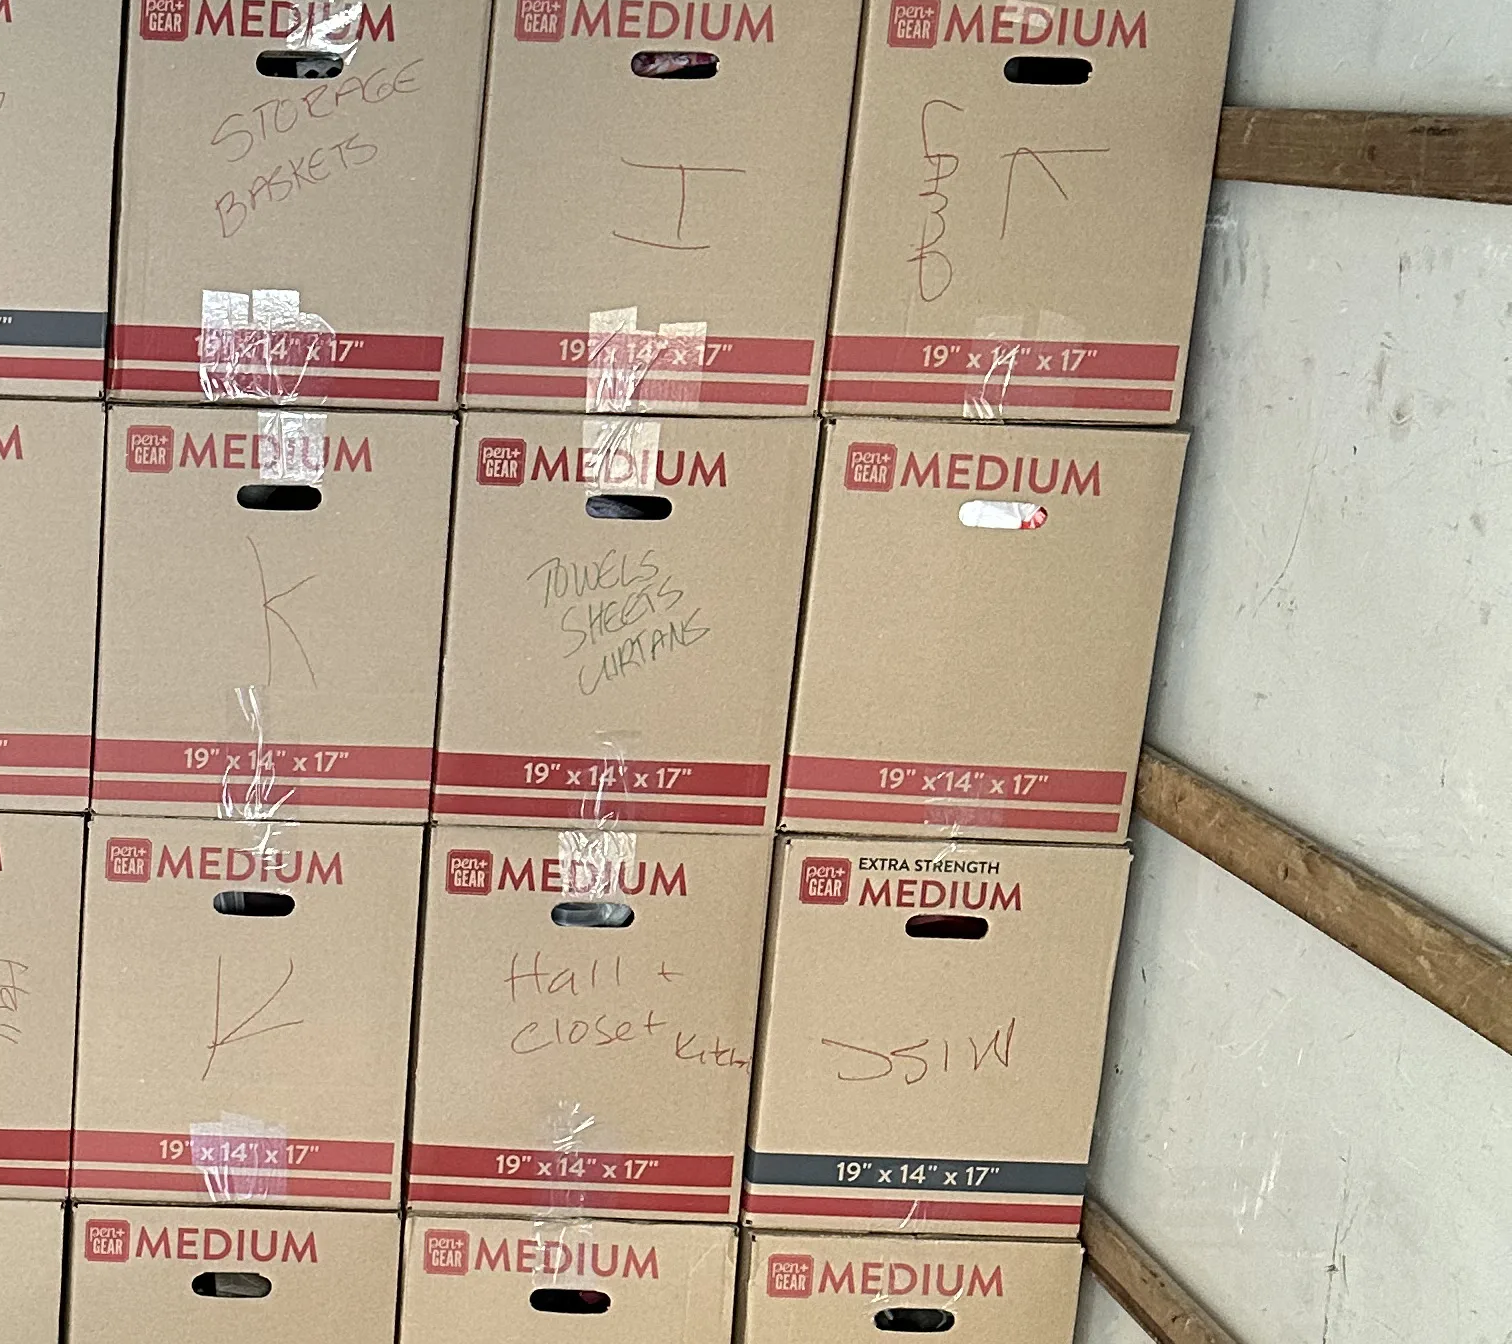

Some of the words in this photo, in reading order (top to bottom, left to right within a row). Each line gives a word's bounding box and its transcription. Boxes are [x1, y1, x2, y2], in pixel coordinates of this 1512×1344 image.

[896, 19, 931, 40] GEAR
[943, 3, 1148, 49] MEDIUM
[210, 58, 424, 162] STORAGE
[215, 133, 378, 239] BASKETS
[530, 445, 727, 488] MEDIUM
[854, 465, 887, 484] GEAR
[900, 451, 1101, 496] MEDIUM
[527, 548, 659, 608] TOWELS
[246, 536, 318, 689] K
[184, 747, 220, 769] 19"
[226, 754, 241, 769] x
[248, 749, 286, 771] 14"
[292, 756, 307, 772] x
[314, 751, 350, 773] 17"
[878, 767, 916, 789] 19"
[921, 776, 936, 791] x
[944, 770, 985, 793] 14"
[989, 779, 1005, 795] x
[1012, 774, 1049, 795] 17"
[157, 844, 343, 884] MEDIUM
[497, 857, 687, 896] MEDIUM
[859, 857, 910, 872] EXTRA
[914, 859, 1000, 875] STRENGTH
[808, 878, 843, 897] GEAR
[858, 877, 1023, 912] MEDIUM
[505, 951, 620, 1002] Hall
[159, 1140, 194, 1159] 19"
[200, 1146, 215, 1161] x
[221, 1142, 258, 1162] 14"
[265, 1149, 278, 1163] x
[286, 1145, 319, 1164] 17"
[837, 1161, 873, 1182] 19"
[877, 1169, 892, 1184] x
[899, 1164, 938, 1185] 14"
[943, 1171, 957, 1186] x
[965, 1167, 1000, 1186] 17"
[135, 1226, 318, 1263] MEDIUM
[474, 1236, 659, 1280] MEDIUM
[775, 1273, 806, 1291] GEAR
[818, 1260, 1004, 1297] MEDIUM
